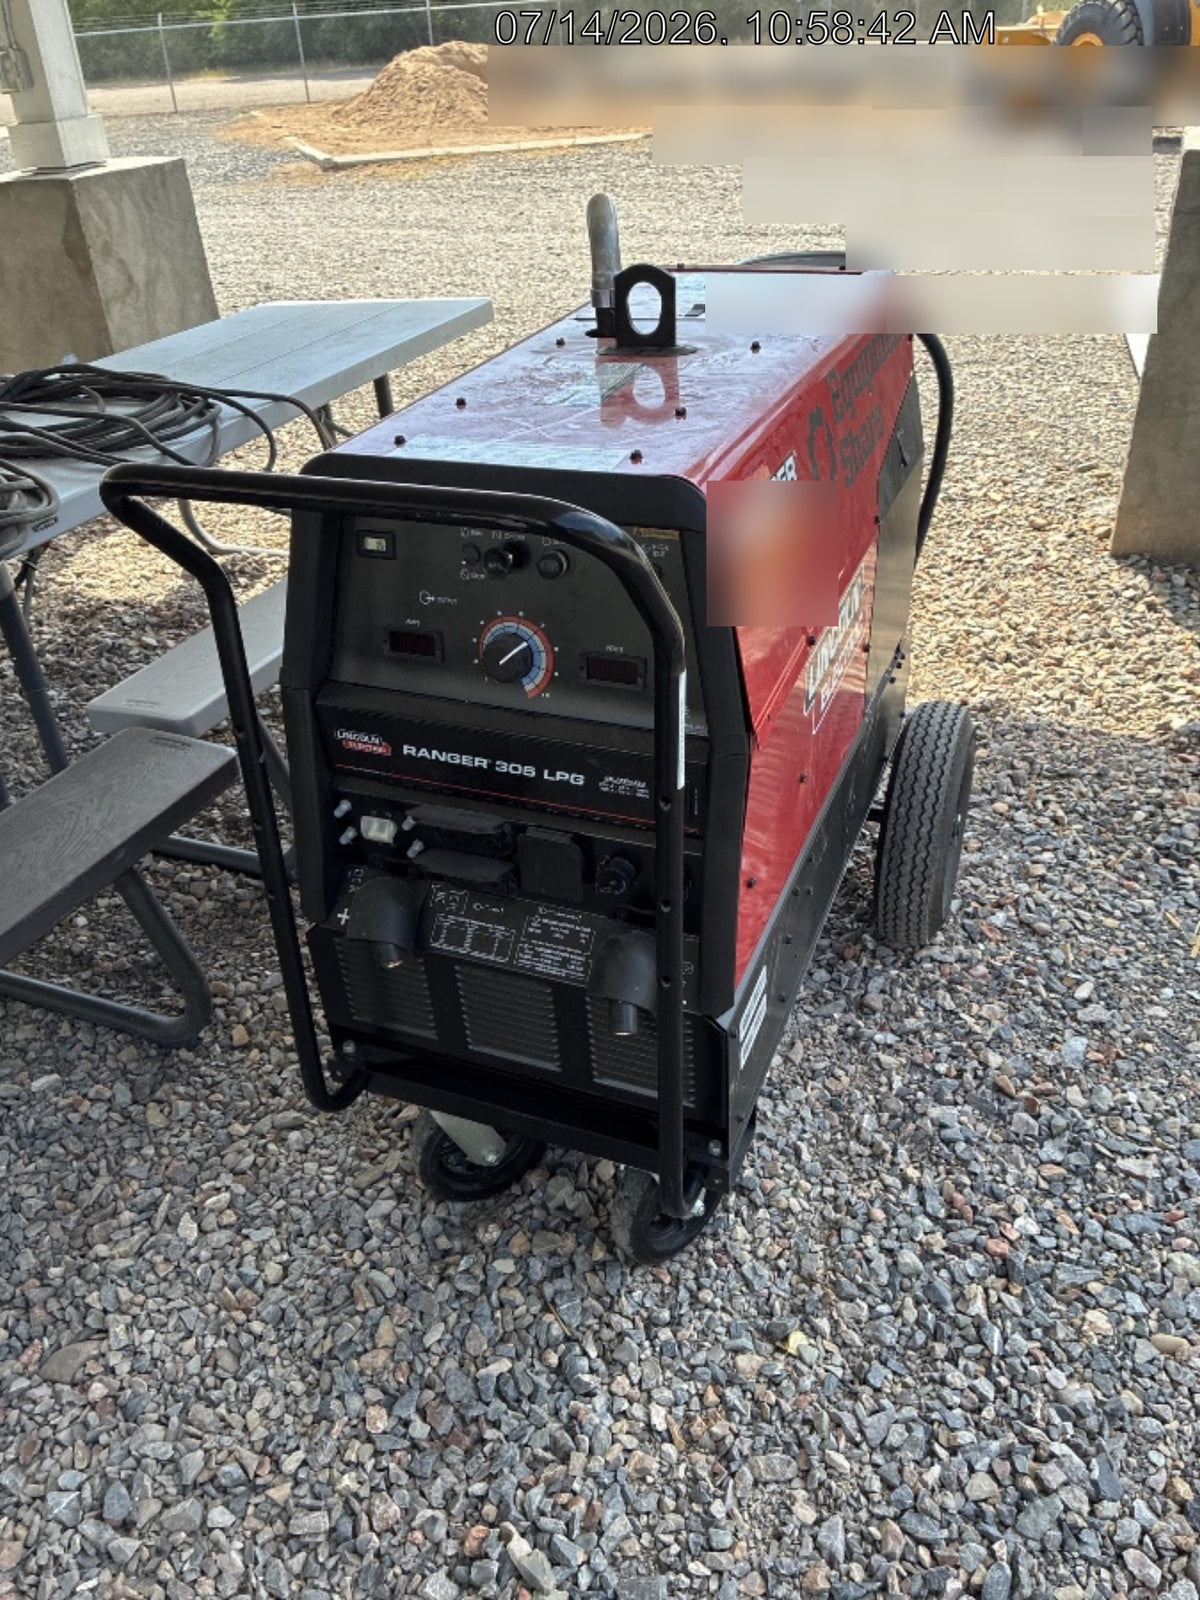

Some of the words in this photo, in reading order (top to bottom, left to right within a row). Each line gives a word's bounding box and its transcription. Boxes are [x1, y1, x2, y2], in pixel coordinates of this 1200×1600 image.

[824, 334, 905, 425] Equipm
[402, 744, 489, 769] RANGER
[495, 760, 536, 778] 305
[544, 769, 586, 787] LPG
